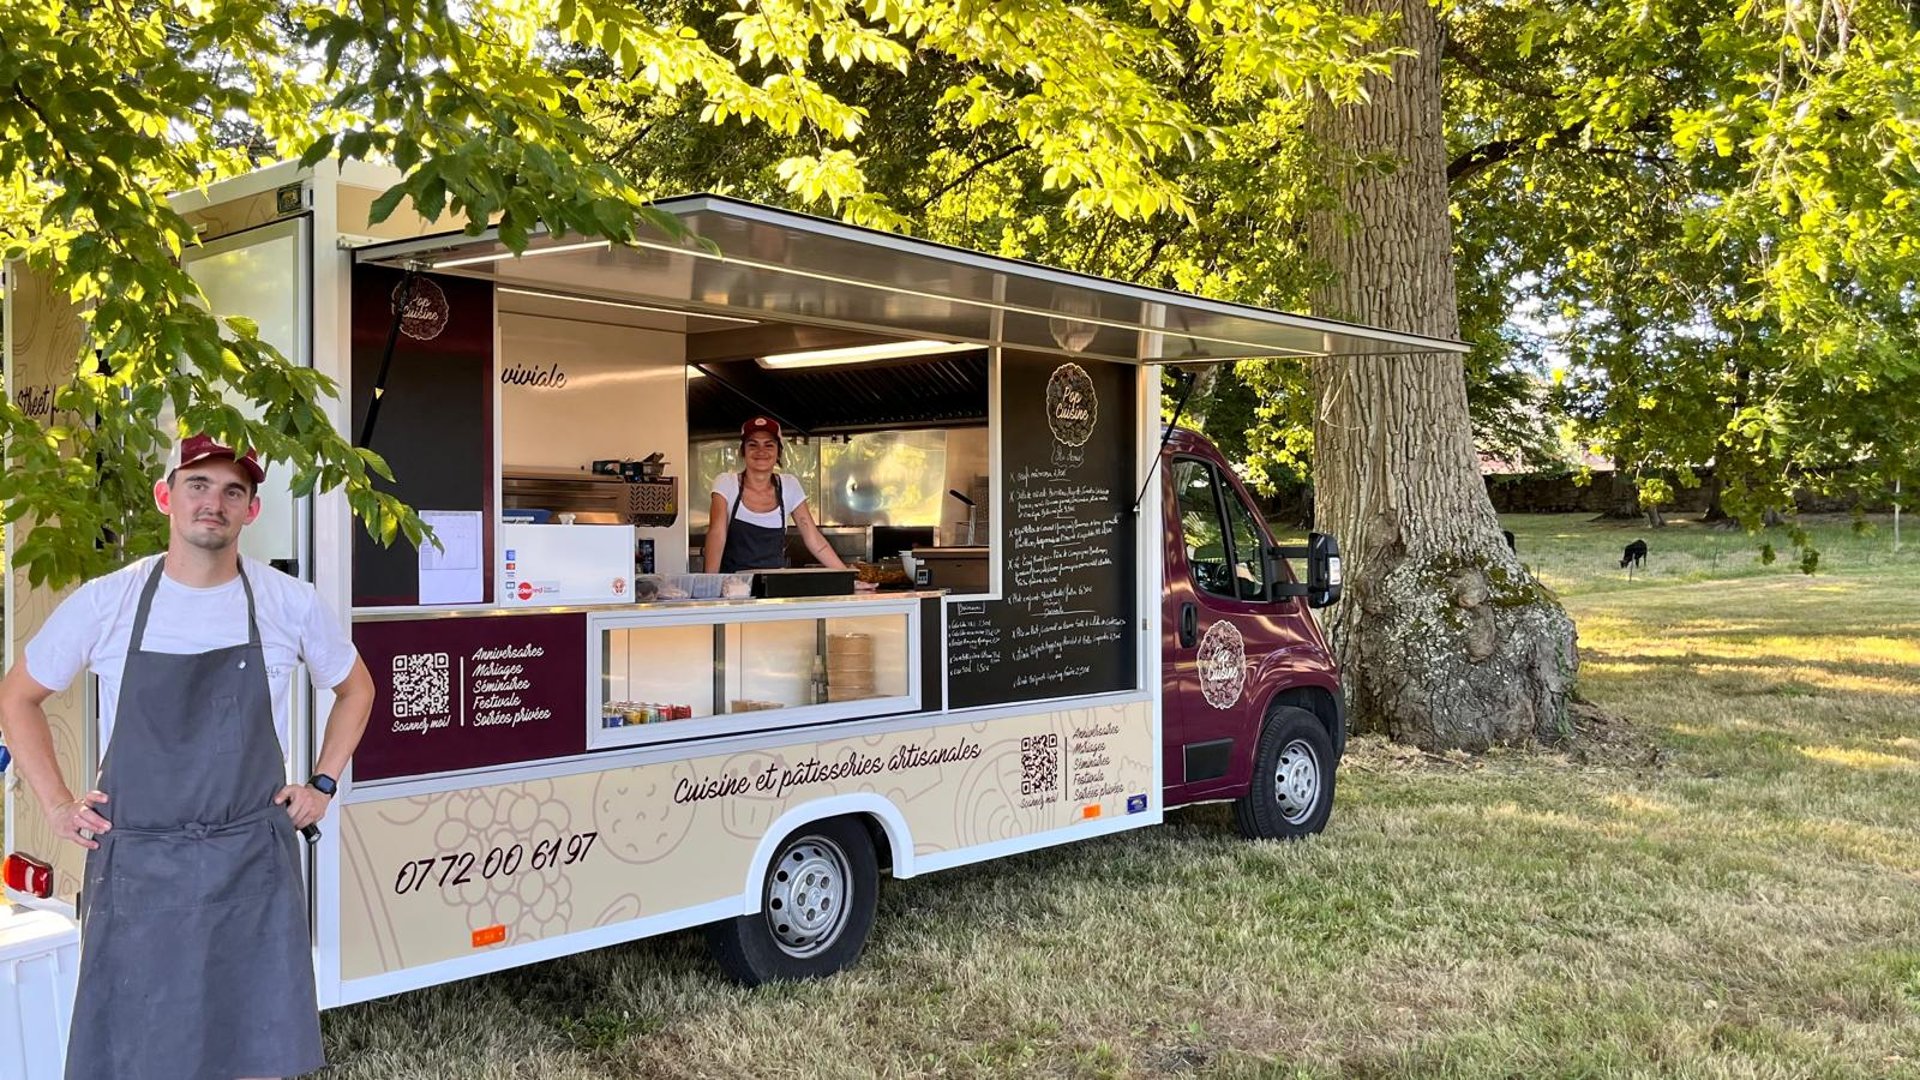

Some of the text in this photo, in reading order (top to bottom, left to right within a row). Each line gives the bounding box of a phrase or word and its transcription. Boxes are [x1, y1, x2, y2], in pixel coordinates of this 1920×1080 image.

[1063, 386, 1082, 410] Pop
[1055, 403, 1089, 420] Cuisine
[472, 643, 545, 661] Anniversaires
[472, 661, 524, 680] Mariages
[1208, 664, 1238, 681] Cuisine
[472, 676, 531, 694] Séminaires
[472, 692, 521, 710] Festivals
[392, 717, 429, 735] Scannez
[473, 707, 551, 728] Soirées privées
[1072, 722, 1120, 740] Anniversaires
[1073, 740, 1106, 756] Mariages
[673, 737, 982, 804] Cuisine et pâtisseries artisanales
[1073, 754, 1111, 771] Séminaires
[1073, 771, 1104, 785] Festivals
[395, 832, 598, 893] 07 72 00 61 97
